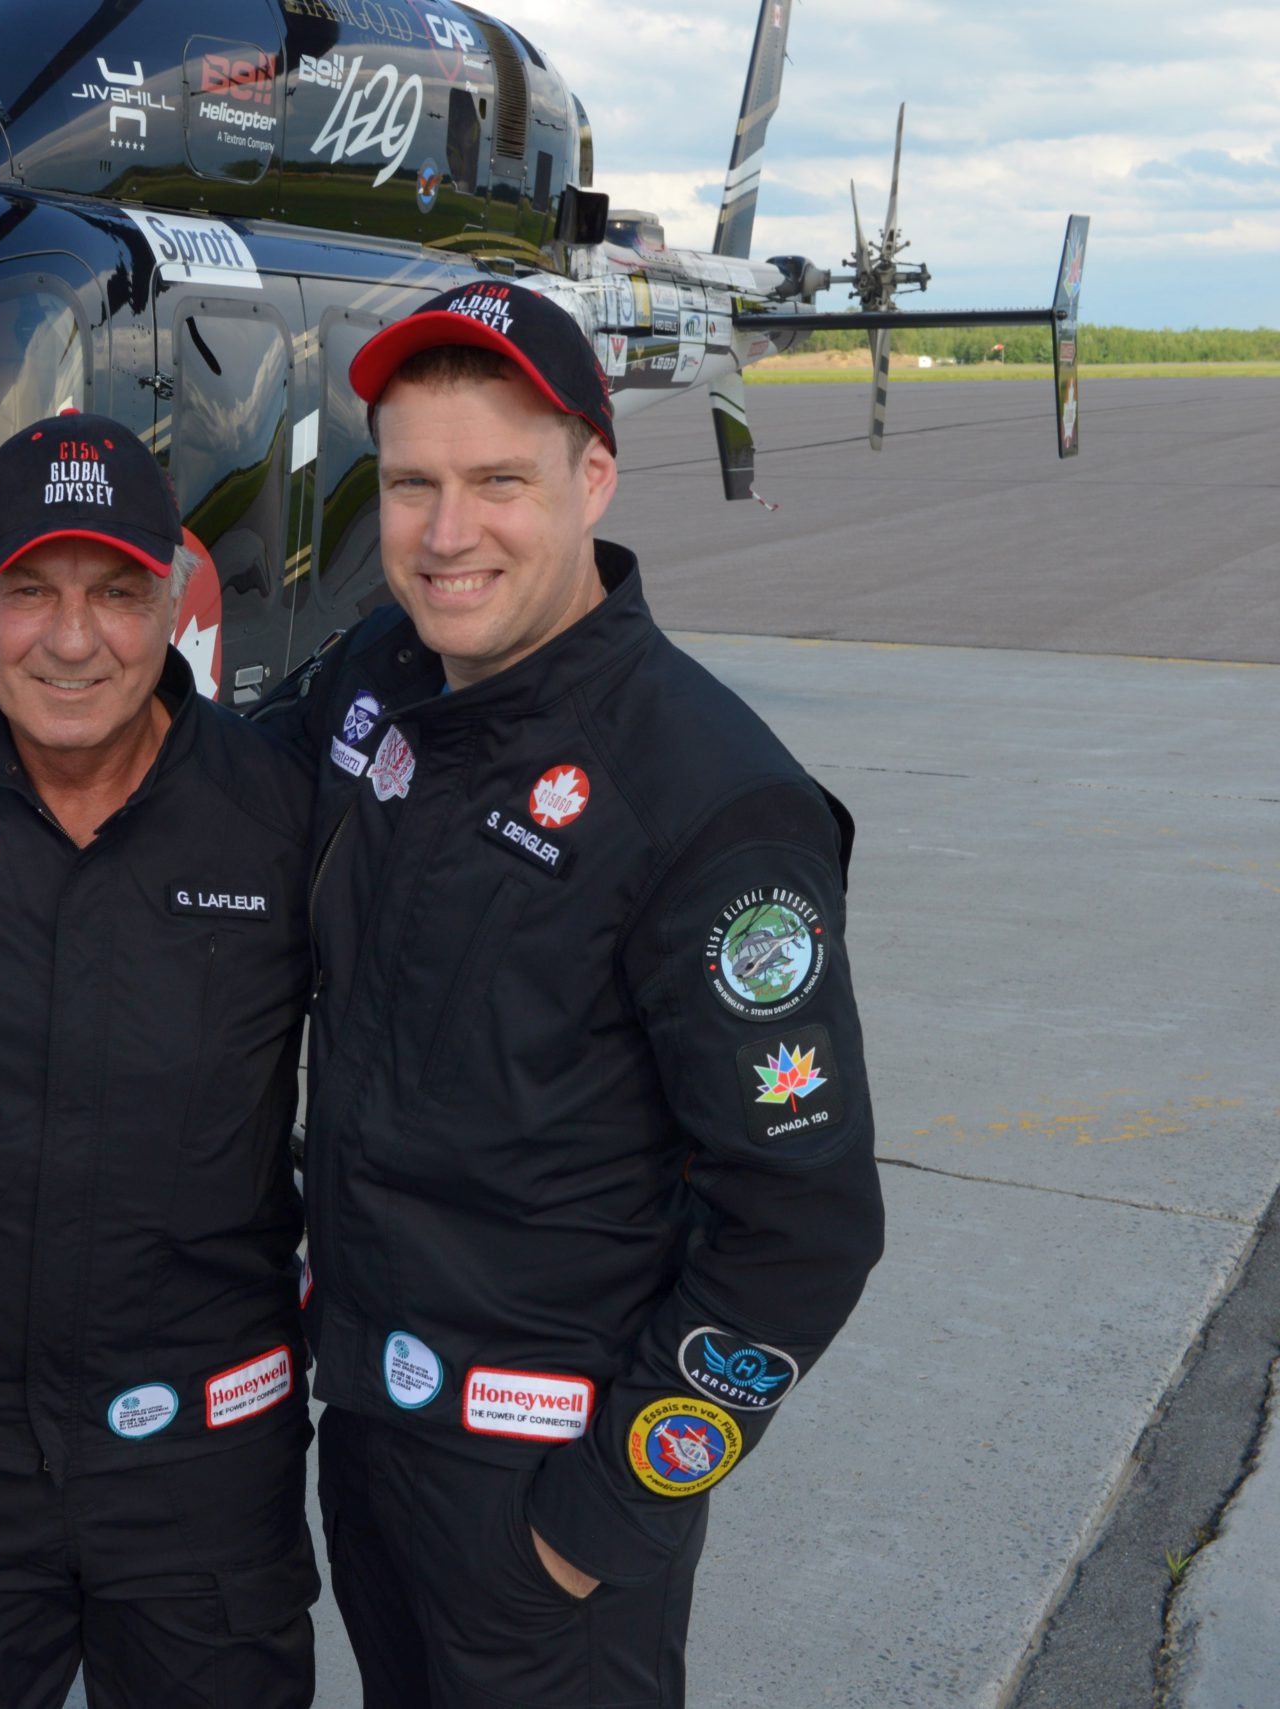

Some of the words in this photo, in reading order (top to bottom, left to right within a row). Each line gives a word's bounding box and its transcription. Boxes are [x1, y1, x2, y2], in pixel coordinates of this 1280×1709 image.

[425, 13, 475, 52] CAP
[201, 52, 278, 105] Bell
[298, 54, 344, 90] Bell
[199, 102, 277, 131] Helicopter
[310, 55, 423, 188] 429
[217, 130, 222, 142] A
[224, 132, 246, 146] Textron
[248, 136, 275, 154] Company
[146, 216, 244, 277] Sprott
[448, 295, 510, 316] GLOBAL
[51, 461, 108, 484] GLOBAL
[44, 482, 113, 506] ODYSSEY
[486, 811, 499, 830] S.
[502, 820, 560, 867] DENGLER
[177, 891, 192, 906] G.
[198, 892, 266, 911] LAFLEUR
[724, 888, 764, 921] GLOBAL
[772, 888, 819, 922] ODYSSEY
[721, 990, 744, 1012] DENGLER
[750, 1008, 773, 1016] STEVEN
[774, 996, 800, 1014] DENGLER
[804, 974, 818, 994] DUGAL
[767, 1117, 810, 1136] CANADA
[810, 1111, 828, 1124] 150
[212, 1360, 287, 1406] Honeywell
[213, 1410, 224, 1418] THE
[226, 1402, 247, 1413] POWER
[248, 1398, 256, 1406] OF
[256, 1381, 288, 1402] CONNECTED
[472, 1382, 583, 1412] Honeywell
[690, 1368, 768, 1406] AEROSTYLE
[470, 1408, 484, 1418] THE
[486, 1410, 515, 1421] POWER
[517, 1414, 528, 1422] OF
[530, 1416, 582, 1428] CONNECTED
[642, 1404, 680, 1424] Essais
[682, 1404, 698, 1412] en
[700, 1408, 718, 1420] vol
[720, 1420, 738, 1448] Flight
[632, 1430, 651, 1471] Bell
